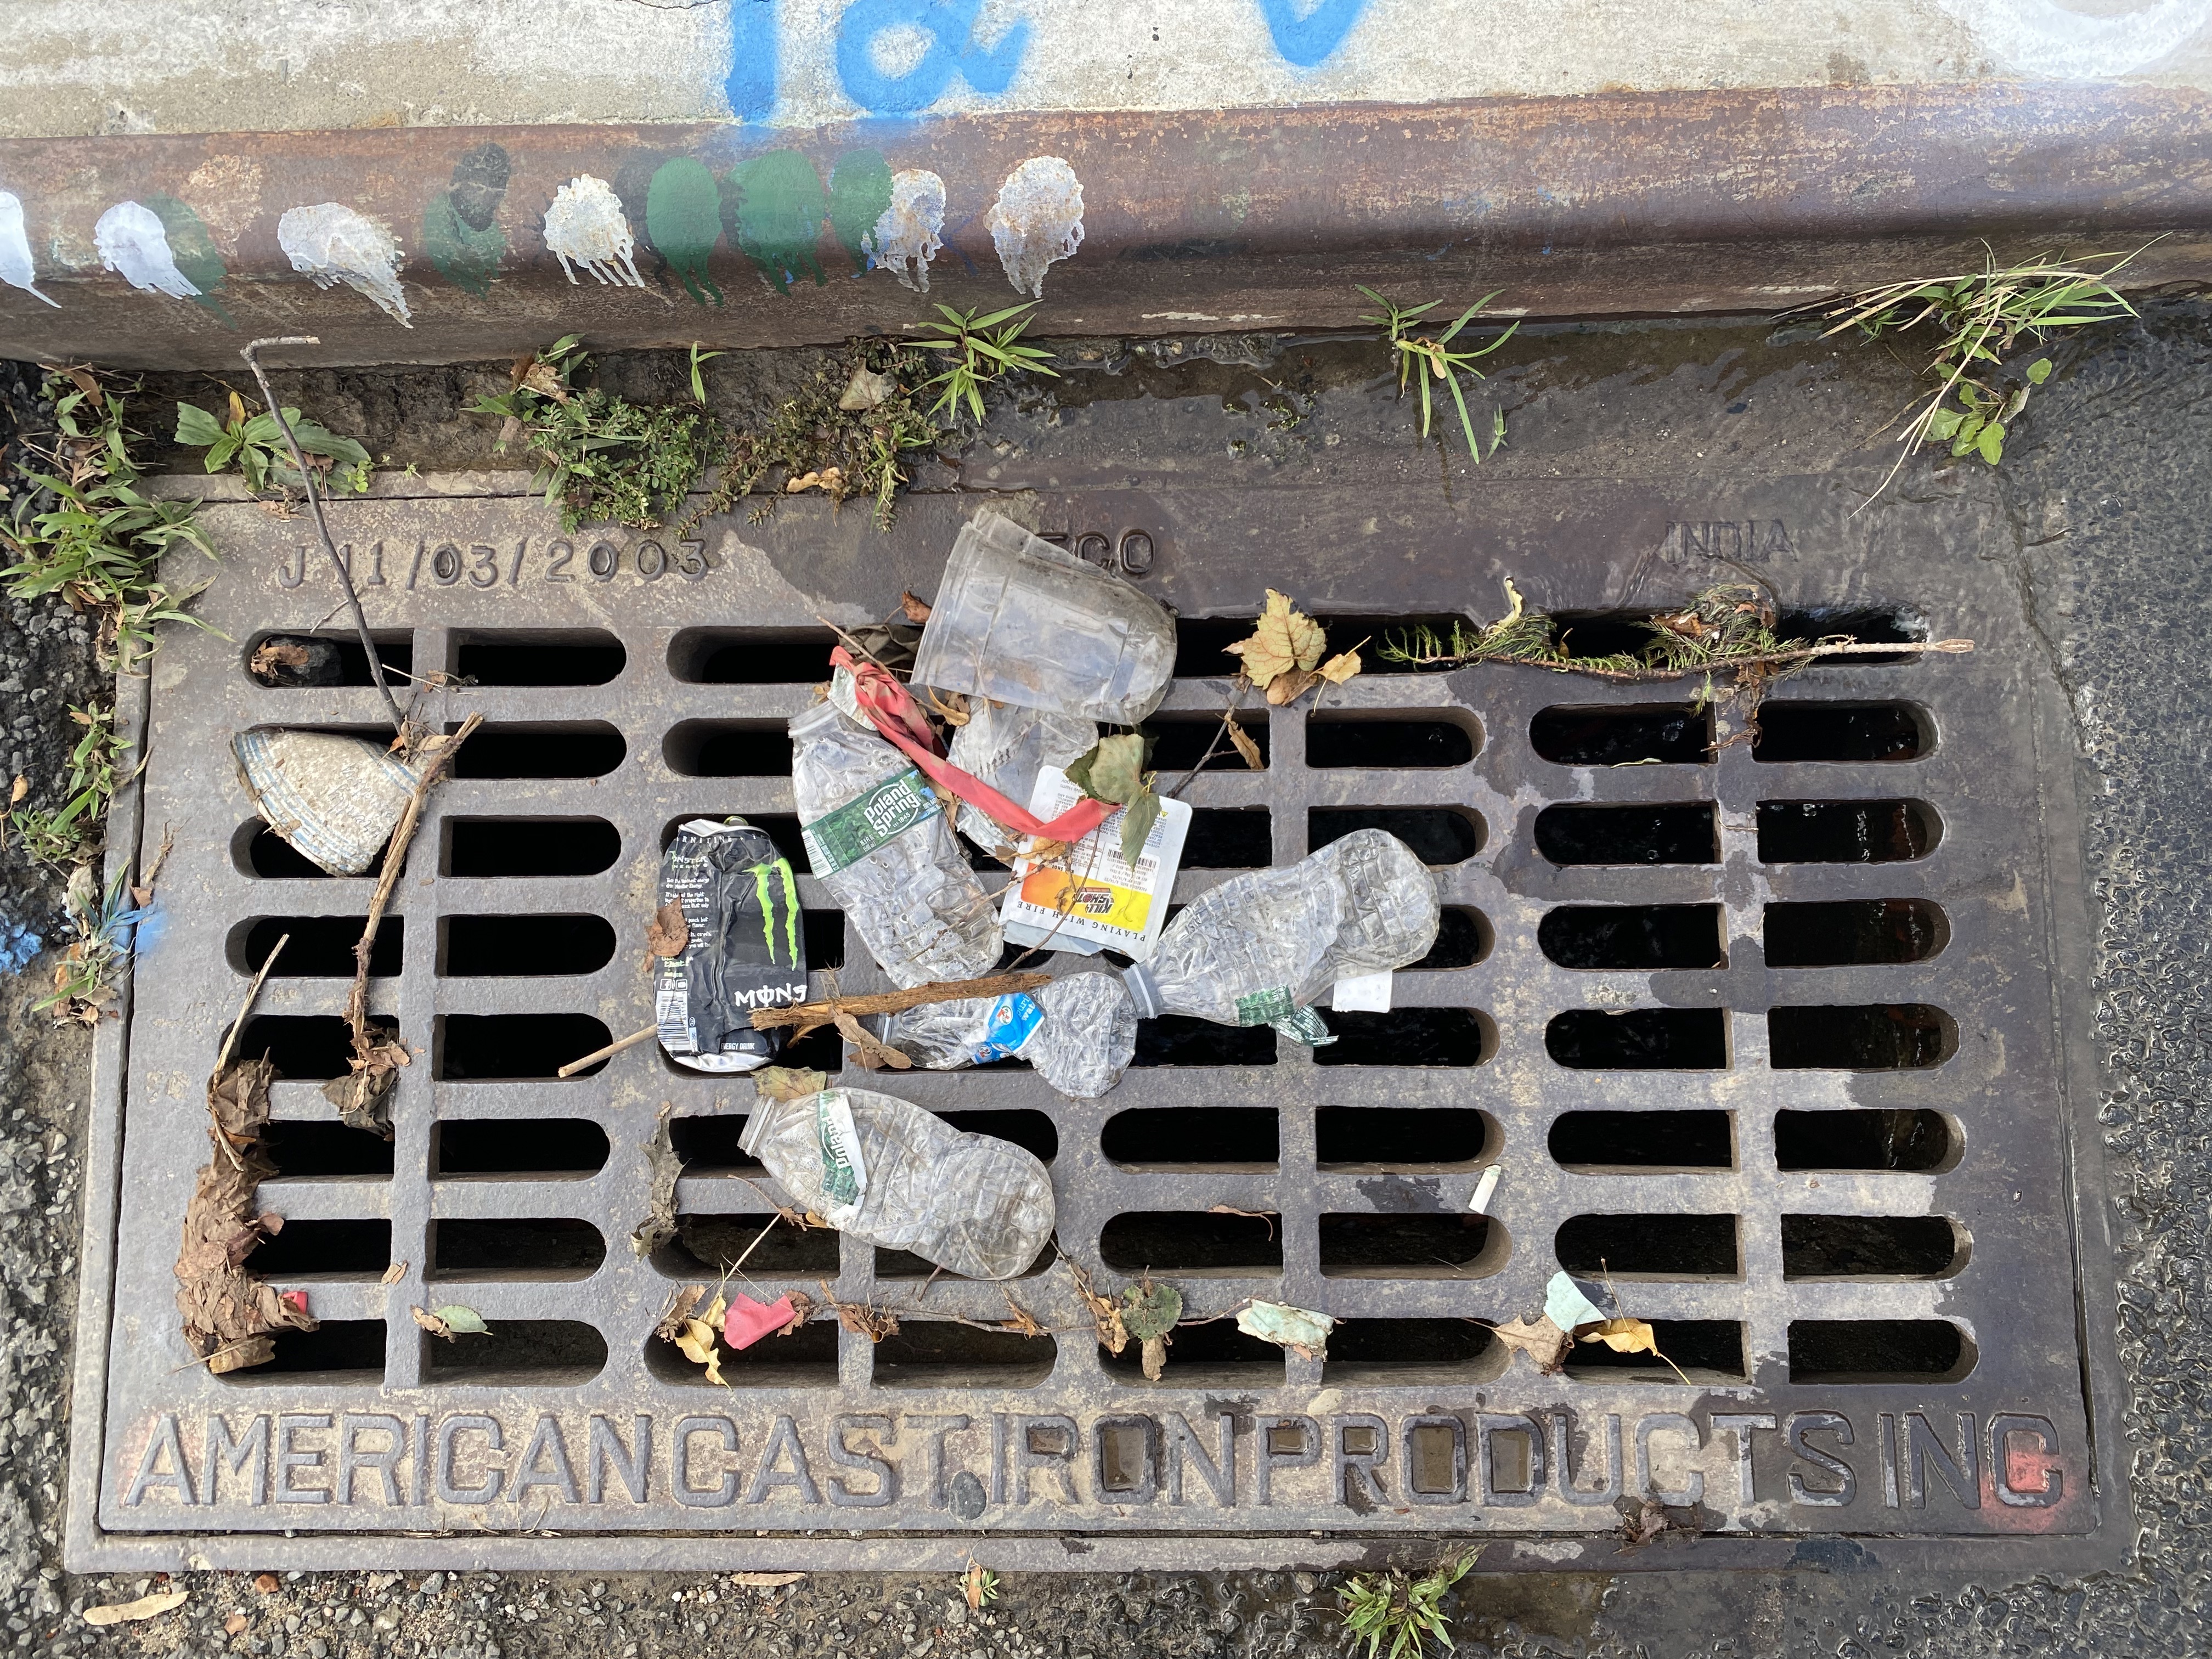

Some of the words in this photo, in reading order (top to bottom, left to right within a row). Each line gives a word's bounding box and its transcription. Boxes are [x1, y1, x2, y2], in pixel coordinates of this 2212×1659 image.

[1666, 519, 1798, 563] INDIA
[864, 779, 913, 824] Poland
[872, 793, 922, 838] Spring
[898, 812, 911, 823] 1845
[1017, 901, 1045, 914] FIRE
[1076, 892, 1111, 905] SHOT
[1086, 895, 1115, 914] KILL
[1091, 921, 1146, 942] PLAYING
[122, 1413, 651, 1507] AMERICAN
[670, 1413, 969, 1509] CAST
[990, 1412, 1235, 1509] IRON
[1255, 1410, 1858, 1509] PRODUCTS
